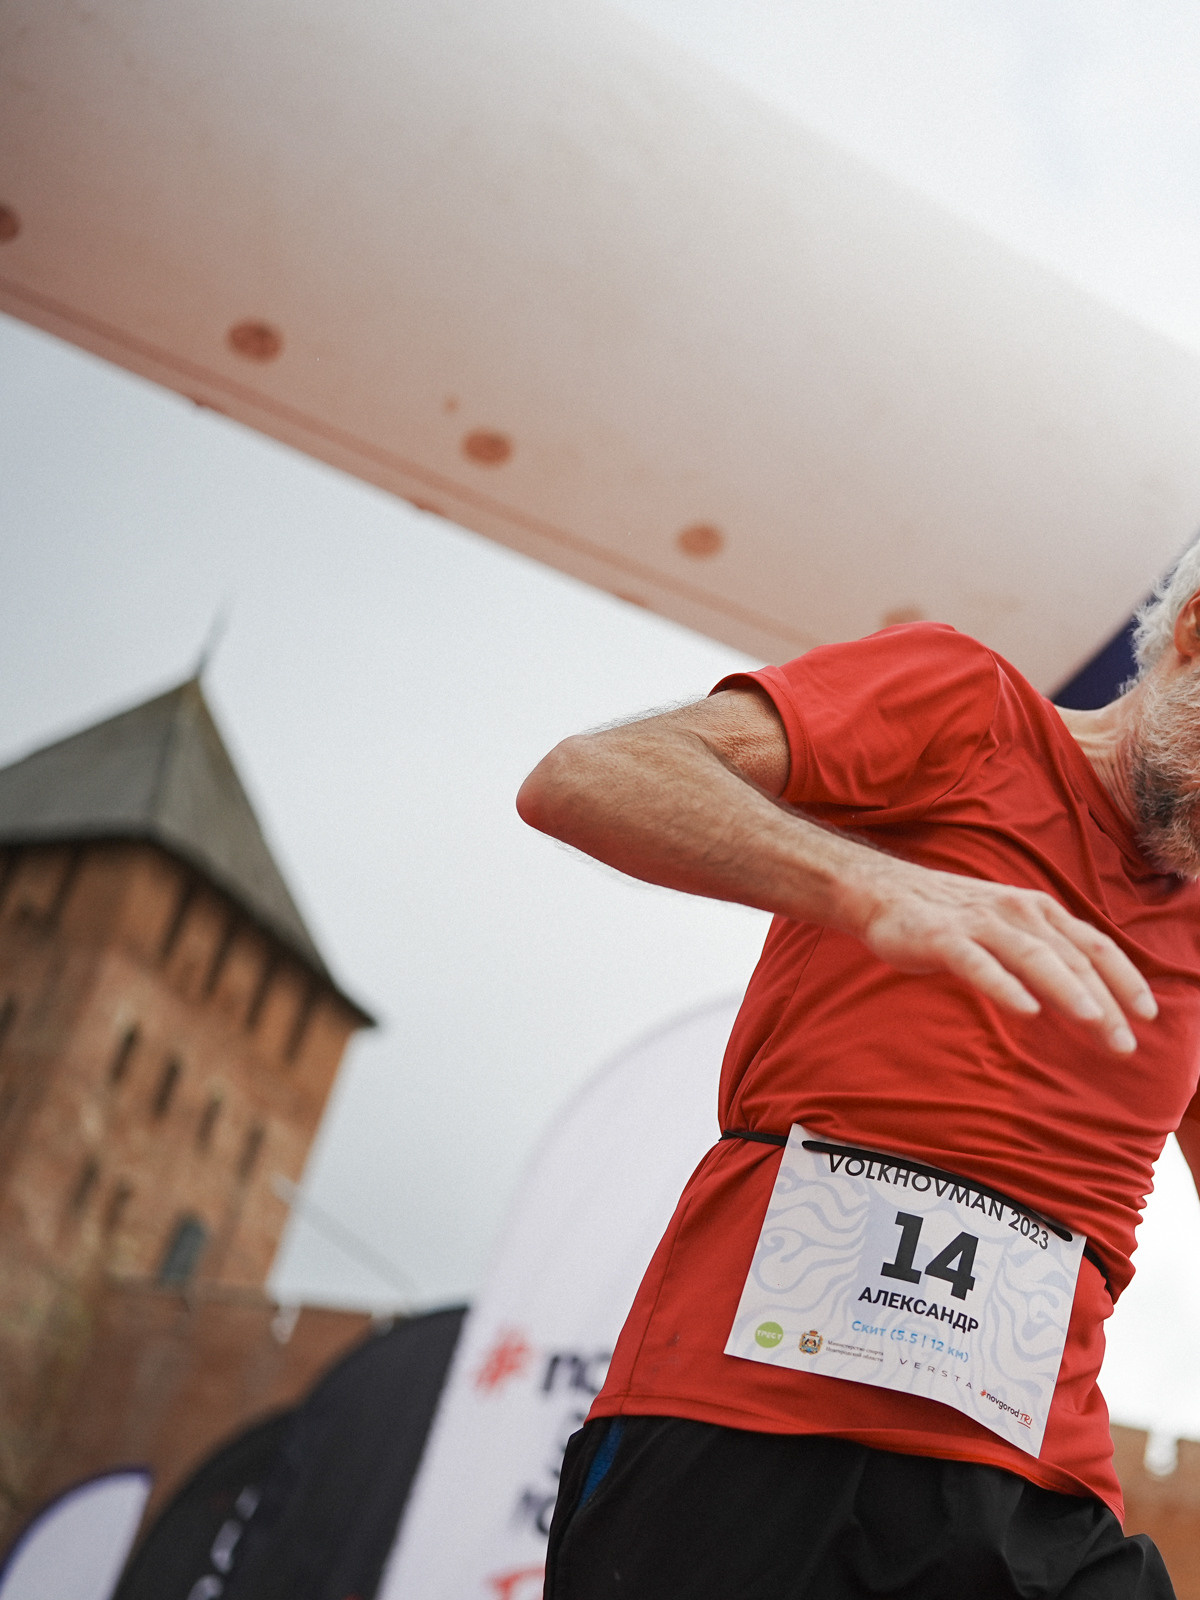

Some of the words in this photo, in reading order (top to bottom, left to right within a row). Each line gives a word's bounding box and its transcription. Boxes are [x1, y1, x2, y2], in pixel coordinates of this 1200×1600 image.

[829, 1153, 1005, 1222] VOLKHOVMAN
[1007, 1209, 1050, 1251] 2023
[880, 1211, 979, 1300] 14
[857, 1286, 980, 1334] АЛЕКСАНДР
[851, 1320, 888, 1337] Скит
[889, 1328, 919, 1345] (5.5
[930, 1338, 945, 1353] 12
[947, 1345, 970, 1363] км)
[899, 1357, 974, 1390] VERSTA
